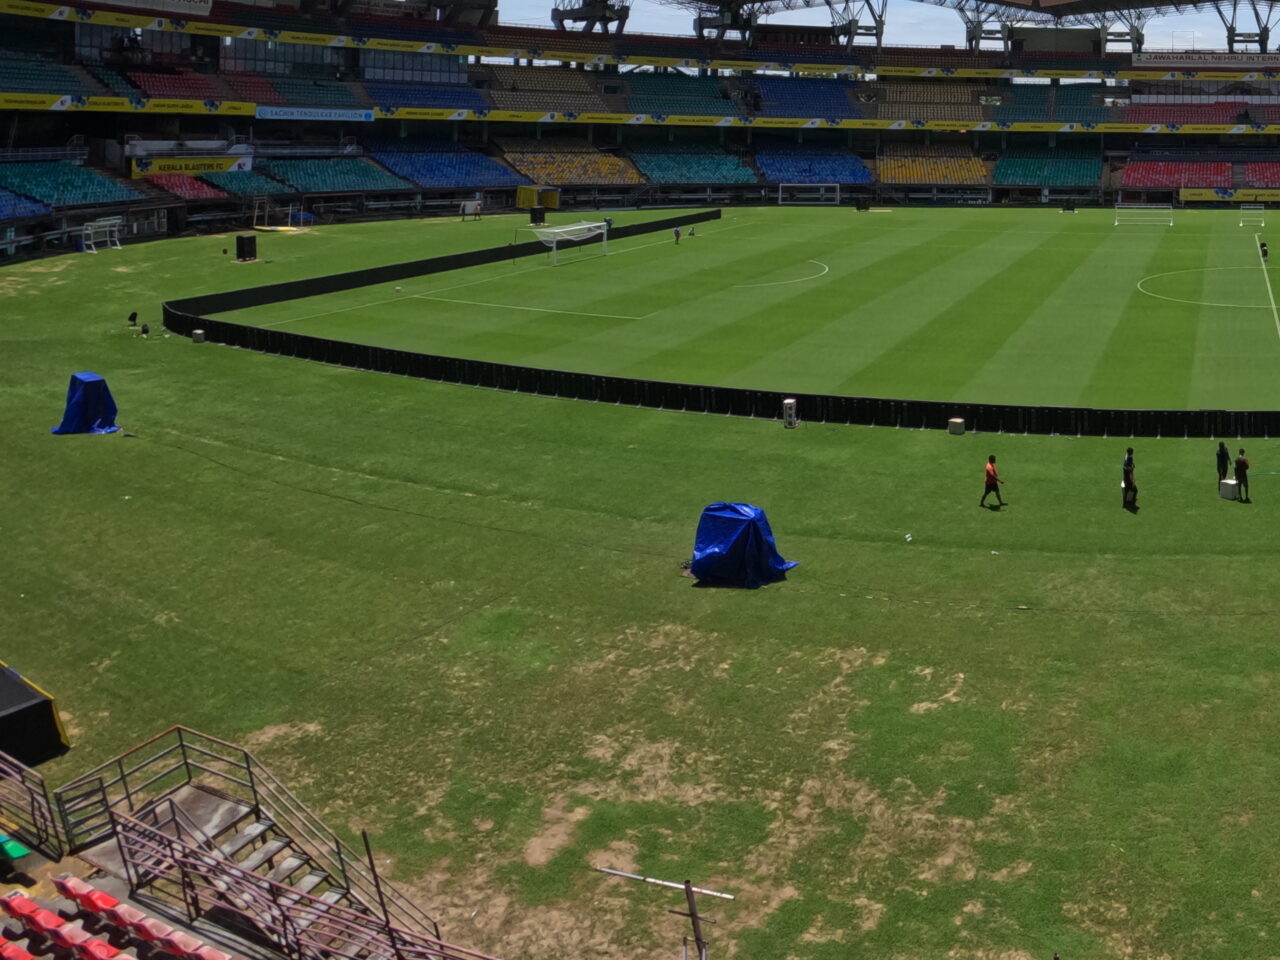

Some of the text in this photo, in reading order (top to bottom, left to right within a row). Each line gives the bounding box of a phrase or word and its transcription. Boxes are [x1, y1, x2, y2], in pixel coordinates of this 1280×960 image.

[334, 111, 363, 119] PAVILION
[158, 162, 224, 172] KERALA BLASTERS FC
